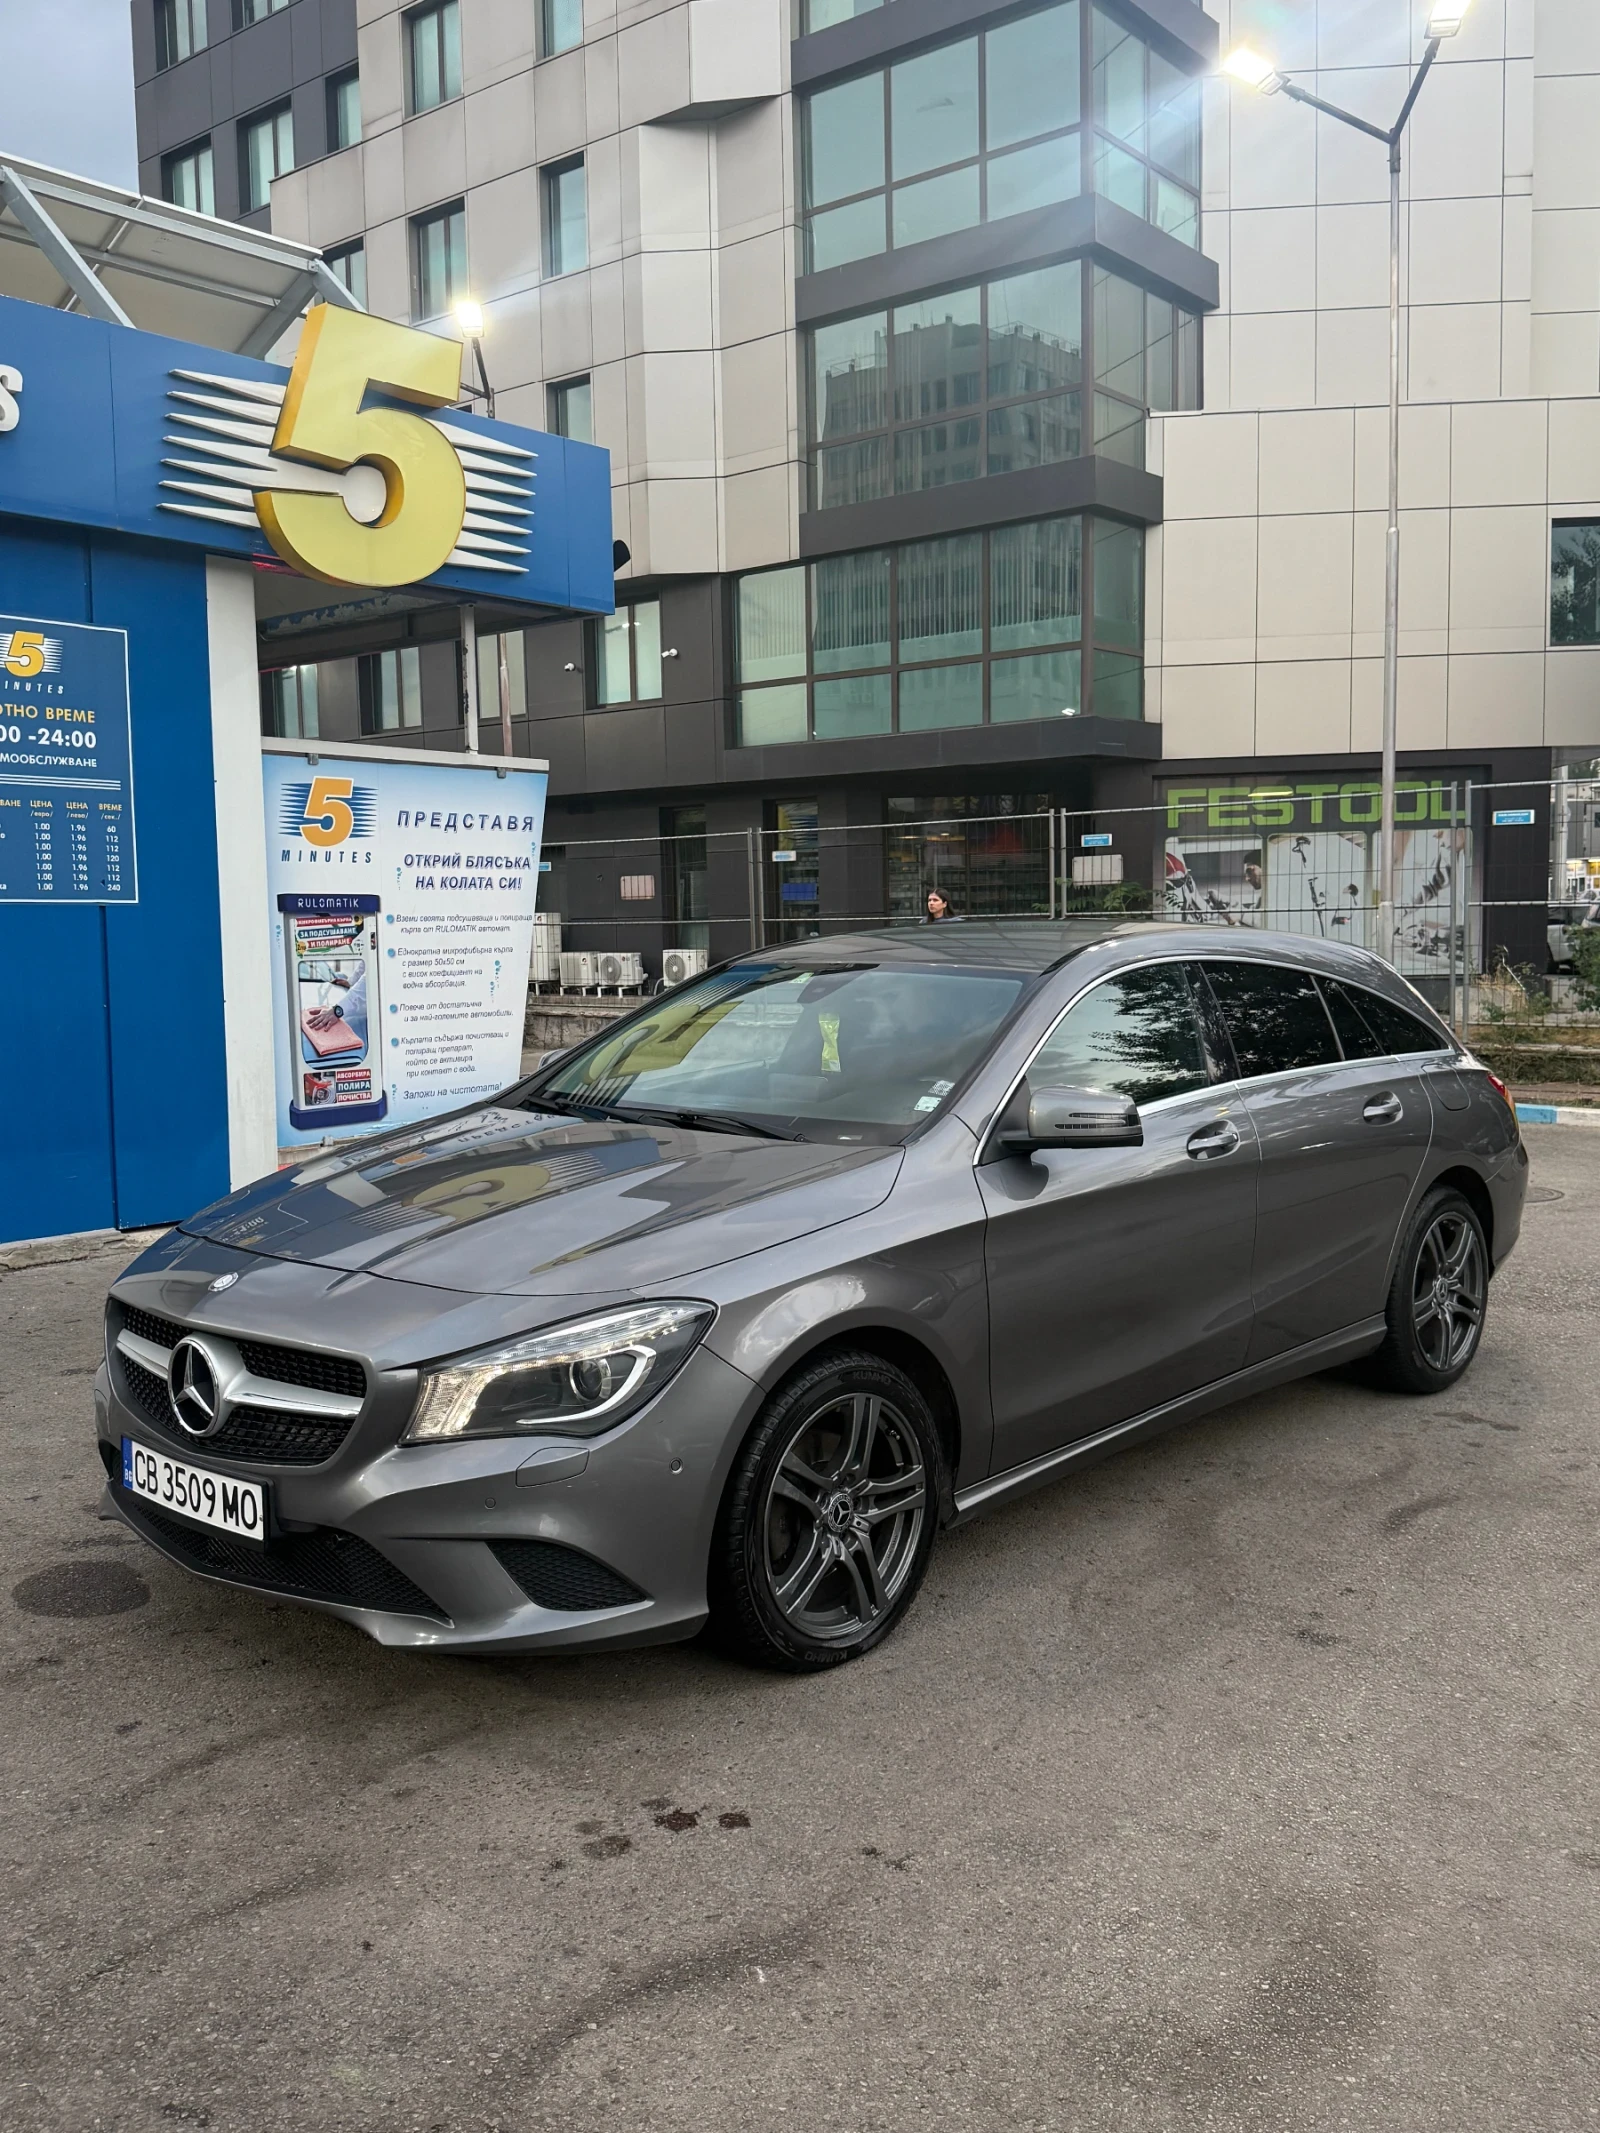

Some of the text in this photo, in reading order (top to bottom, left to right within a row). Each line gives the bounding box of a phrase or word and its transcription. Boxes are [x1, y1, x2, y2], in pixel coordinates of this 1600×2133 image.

[253, 302, 466, 587] 5
[4, 630, 45, 677] 5
[0, 703, 96, 723] ТНО ВРЕМЕ
[30, 799, 53, 808] ЦЕНА
[66, 801, 88, 810] ЦЕНА
[98, 803, 122, 811] ВРЕМЕ
[1166, 780, 1466, 829] FESTOOL
[299, 775, 355, 848] 5
[397, 810, 534, 834] ПРЕДСТАВЯ
[34, 823, 117, 833] 1.00 1.96 60
[71, 834, 86, 842] 1.96
[105, 835, 119, 843] 112
[71, 844, 87, 852] 1.96
[281, 849, 372, 863] MINUTES
[403, 852, 531, 869] ОТКРИЙ БЛЯСЪКА
[36, 863, 52, 871] 1.00
[73, 873, 88, 881] 1.96
[37, 883, 53, 891] 1.00
[415, 875, 522, 890] НА КОЛАТА СИ!
[297, 898, 359, 908] RULOMATIK
[309, 927, 355, 937] ПОДСУШАВАНЕ
[435, 924, 477, 933] RULOMATIK
[316, 938, 351, 947] ПОЛИРАНЕ
[397, 948, 440, 957] Еднократна
[407, 960, 433, 968] размер
[399, 1003, 425, 1011] Повече
[400, 1036, 433, 1046] Кърпата
[434, 1034, 464, 1044] съдържа
[337, 1070, 371, 1079] АБСОРБИРА
[406, 1070, 419, 1079] при
[420, 1067, 453, 1076] контакт
[338, 1081, 371, 1091] ПОЛИРА
[403, 1081, 503, 1100] Заложи на чистотата!
[338, 1092, 371, 1101] ПОЧИСТВА
[124, 1468, 133, 1482] BG
[134, 1450, 258, 1531] CB 3509 MO
